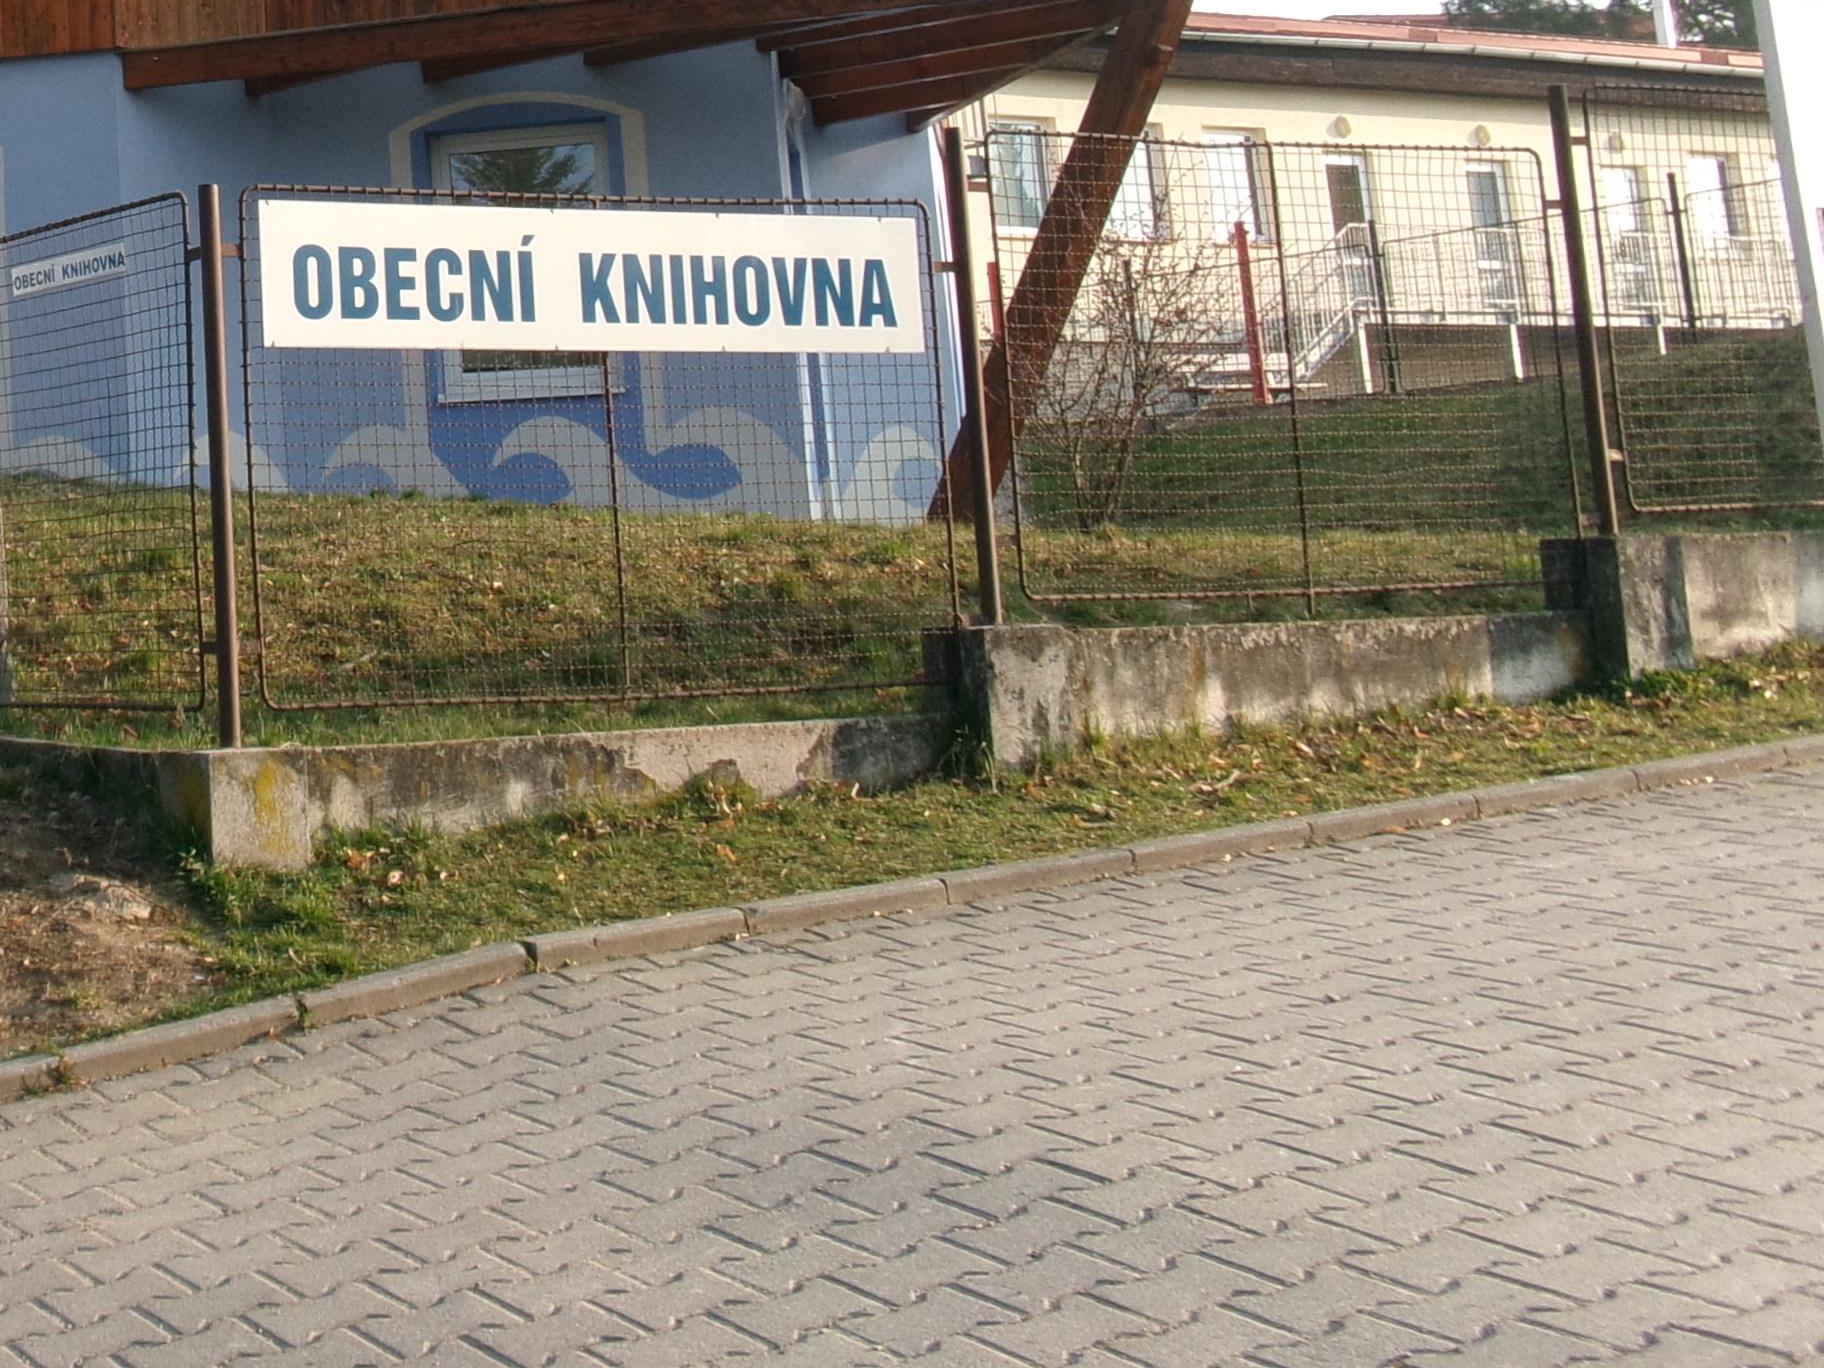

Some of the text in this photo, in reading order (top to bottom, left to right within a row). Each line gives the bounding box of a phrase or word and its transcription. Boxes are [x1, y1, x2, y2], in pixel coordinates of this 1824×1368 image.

[14, 251, 125, 290] OBECNÍ KNIHOVNA
[292, 235, 898, 327] OBECNÍ KNIHOVNA
